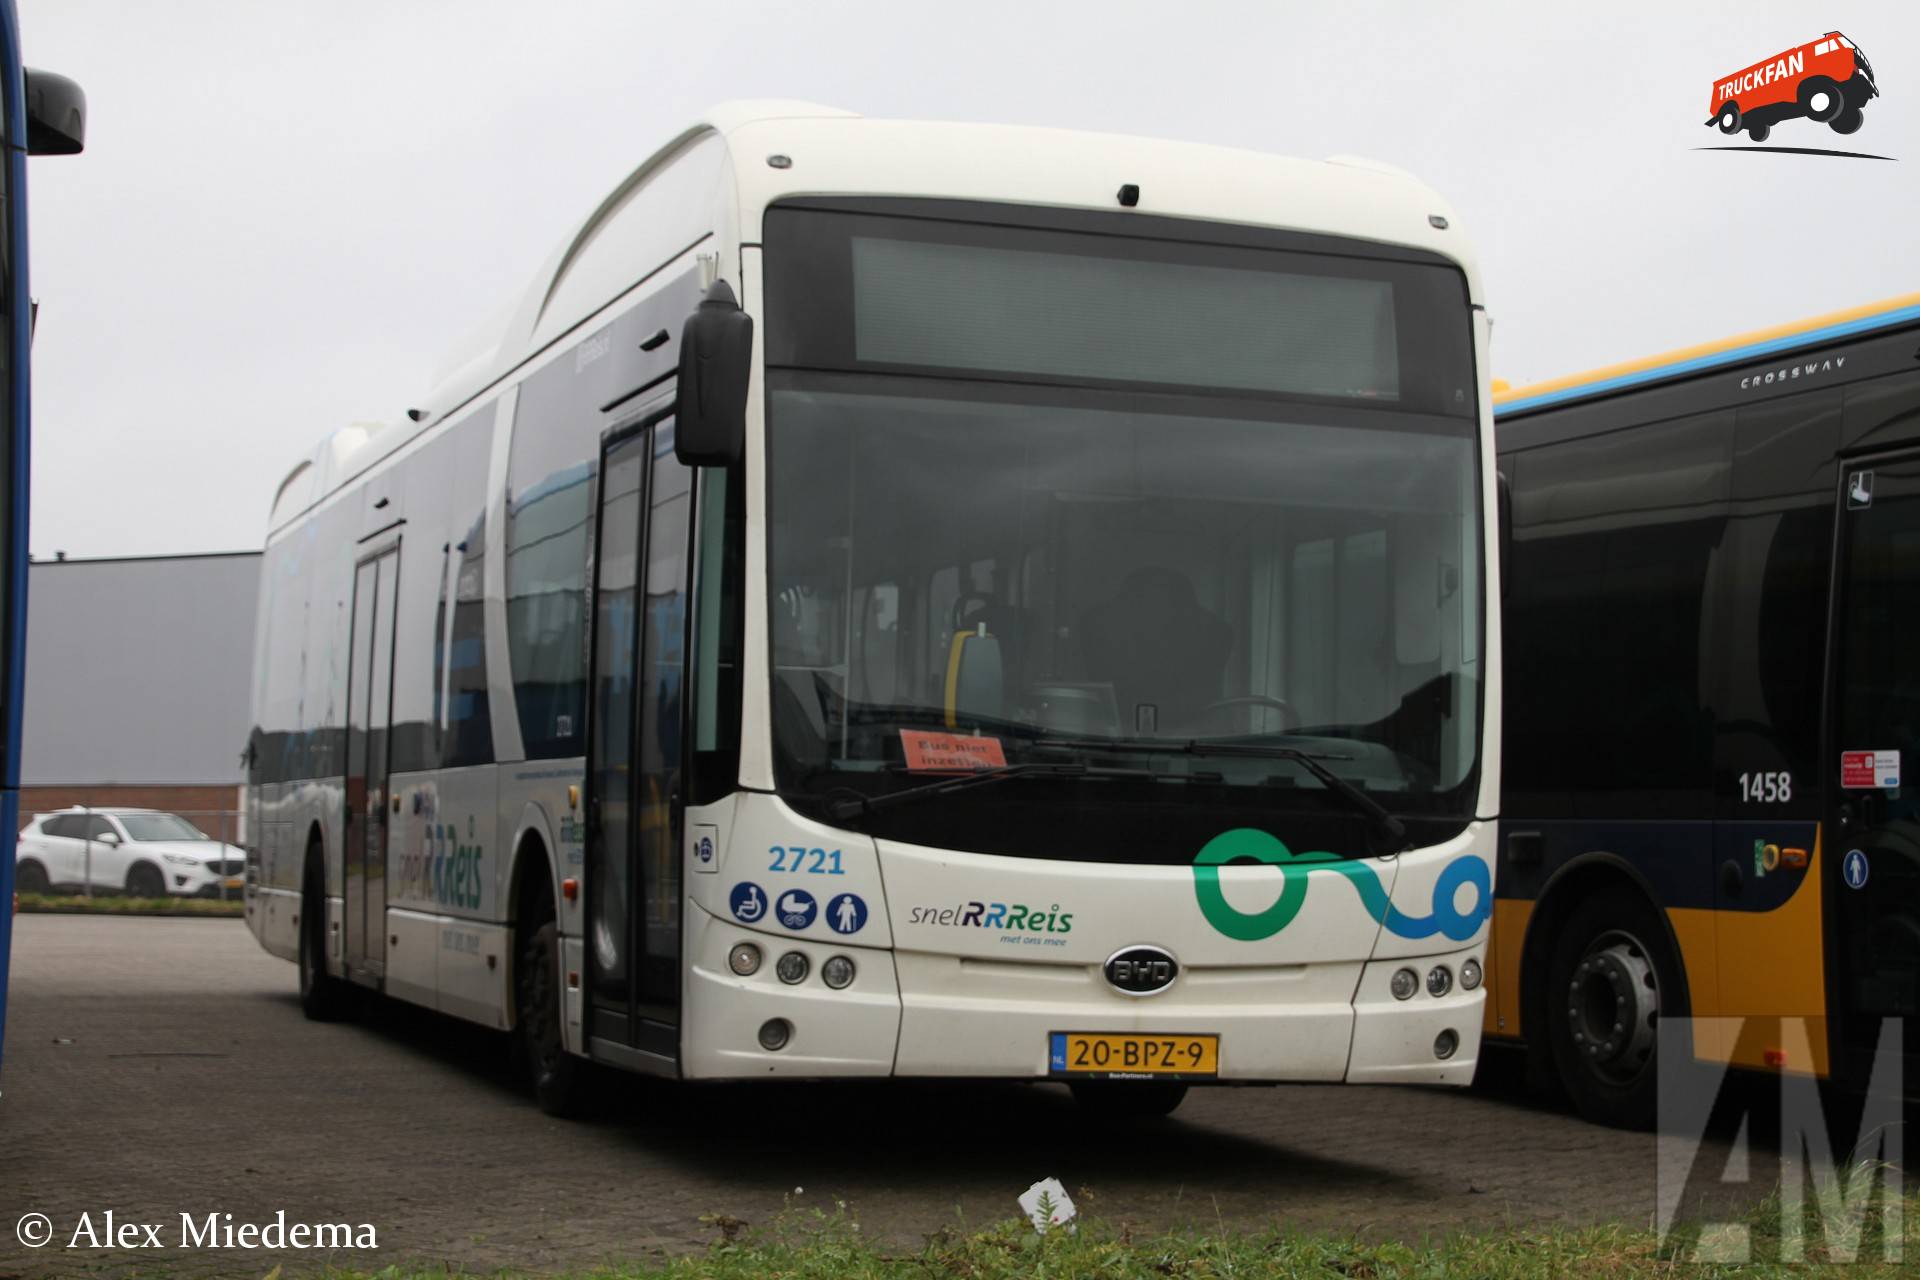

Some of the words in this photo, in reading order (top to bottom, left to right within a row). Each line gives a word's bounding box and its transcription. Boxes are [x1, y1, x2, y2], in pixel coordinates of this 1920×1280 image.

[1739, 772, 1791, 802] 1458
[768, 846, 845, 875] 2721
[909, 902, 1073, 932] snelRRReis
[1000, 935, 1021, 944] met
[1113, 961, 1170, 982] BYD
[1053, 1055, 1064, 1064] NL
[1074, 1040, 1203, 1067] 20-BPZ-9
